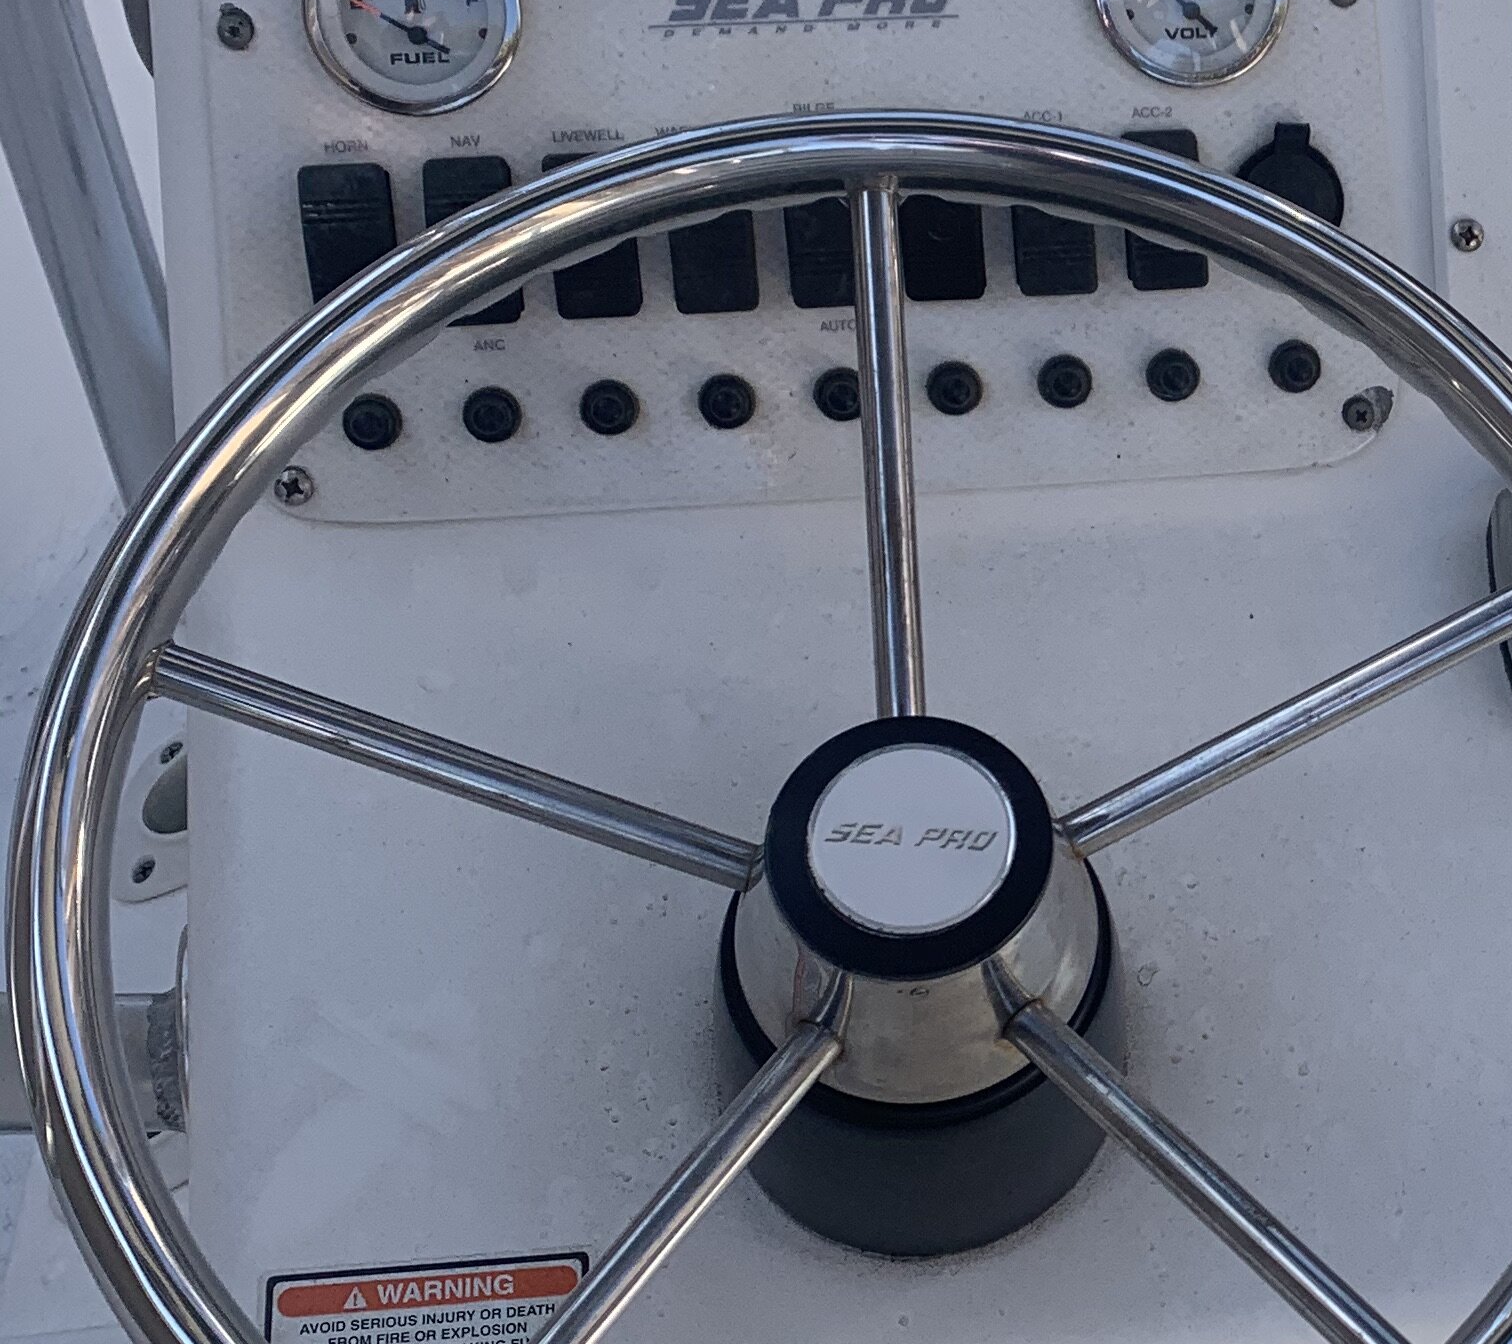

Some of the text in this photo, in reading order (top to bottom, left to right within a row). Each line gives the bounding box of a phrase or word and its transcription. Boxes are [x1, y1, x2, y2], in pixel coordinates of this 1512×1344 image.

[663, 18, 942, 39] DEMAND MORE
[1165, 27, 1218, 40] VOLT
[390, 52, 450, 65] FUEL
[1132, 107, 1173, 119] ACC-2
[450, 134, 481, 148] NAV
[552, 129, 624, 143] LIVEWELL
[324, 140, 369, 153] HORN
[473, 339, 506, 351] ANC
[824, 822, 999, 852] SEA PRO
[377, 1273, 514, 1305] WARNING
[300, 1303, 555, 1336] AVOID SERIOUS INJURY OR DEATH
[377, 1332, 410, 1344] FIRE
[415, 1329, 436, 1342] OR
[441, 1321, 527, 1339] EXPLOSION
